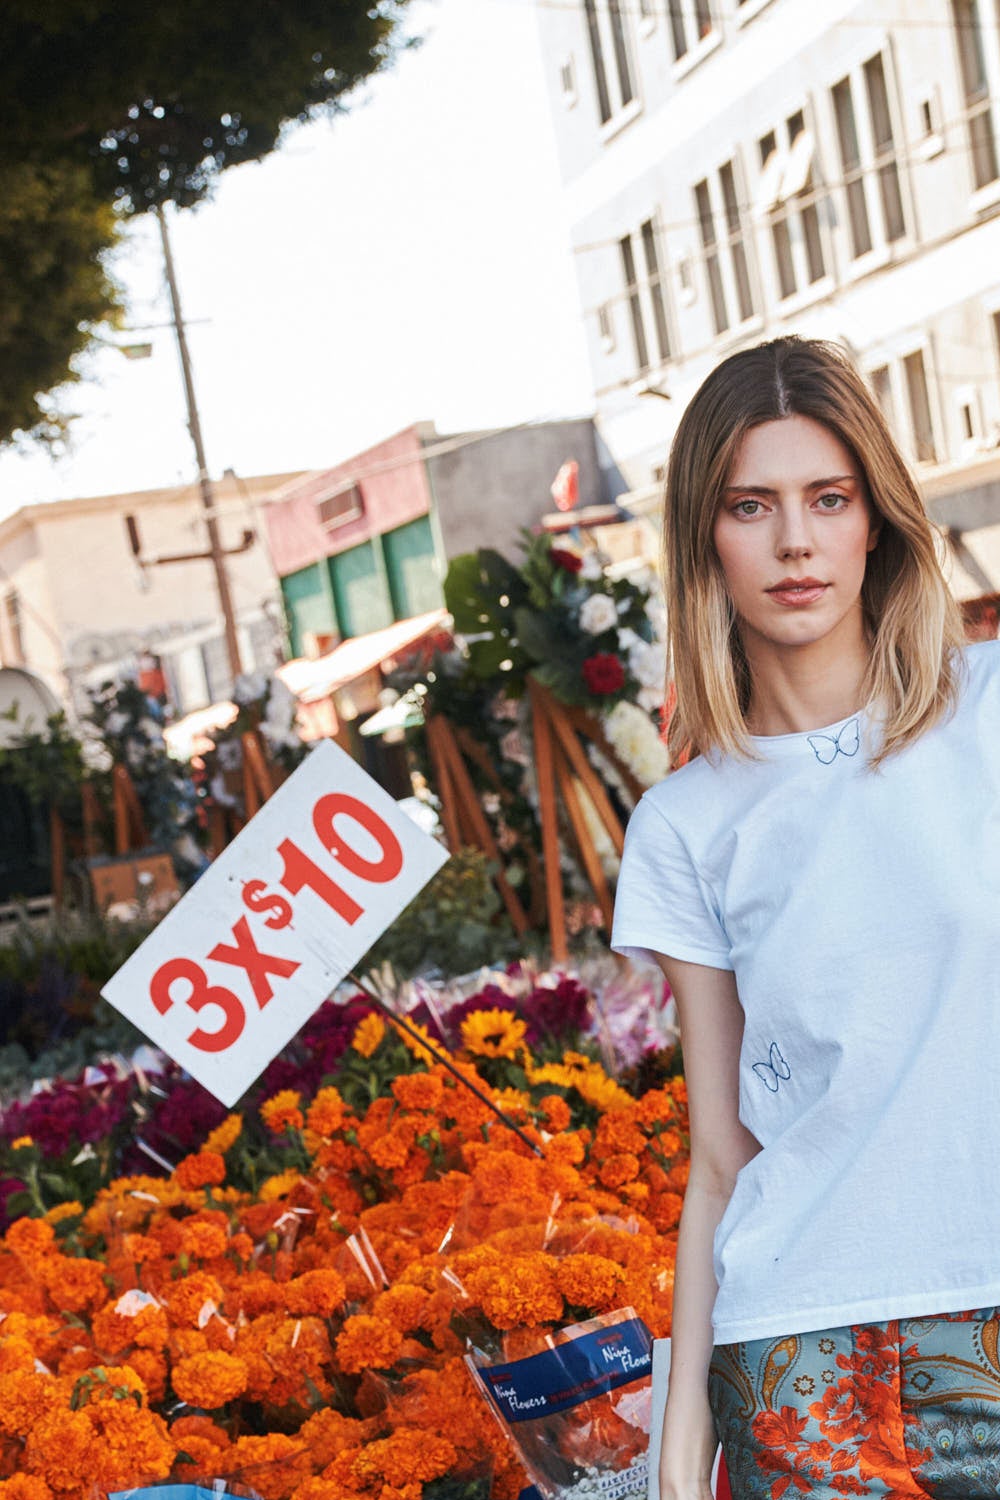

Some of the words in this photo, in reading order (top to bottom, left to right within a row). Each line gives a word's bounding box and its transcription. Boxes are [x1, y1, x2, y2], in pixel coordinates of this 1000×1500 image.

[602, 1345, 631, 1363] Nina
[493, 1384, 516, 1399] Nina
[509, 1395, 547, 1411] Flowers
